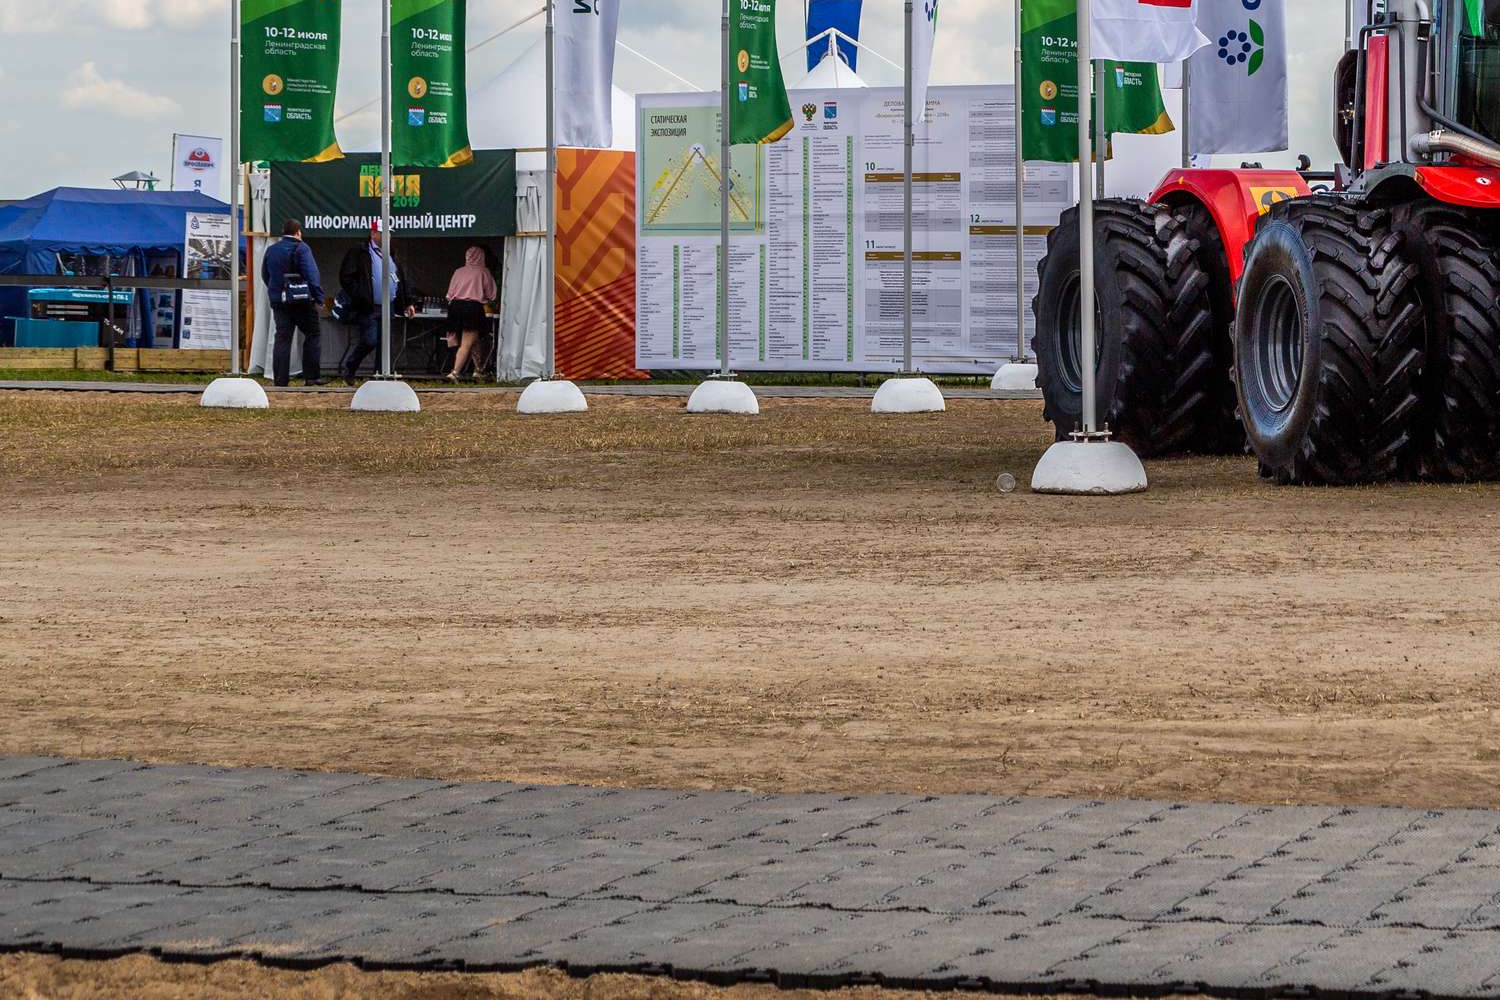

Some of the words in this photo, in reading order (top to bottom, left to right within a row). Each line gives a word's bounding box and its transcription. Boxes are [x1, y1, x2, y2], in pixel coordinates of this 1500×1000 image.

[264, 26, 295, 38] 10-12
[297, 31, 328, 40] июля
[411, 28, 439, 41] 10-12
[264, 40, 326, 50] Ленинградская
[1041, 36, 1069, 48] 10-12
[264, 48, 296, 56] область
[411, 49, 439, 58] область
[1041, 56, 1069, 64] область
[650, 115, 688, 124] СТАТИЧЕСКАЯ
[650, 128, 687, 137] ЭКСПОЗИЦИЯ
[865, 162, 876, 171] 10
[393, 197, 420, 208] 2019
[435, 214, 477, 231] ЦЕНТР
[970, 214, 981, 223] 12
[865, 240, 875, 249] 11
